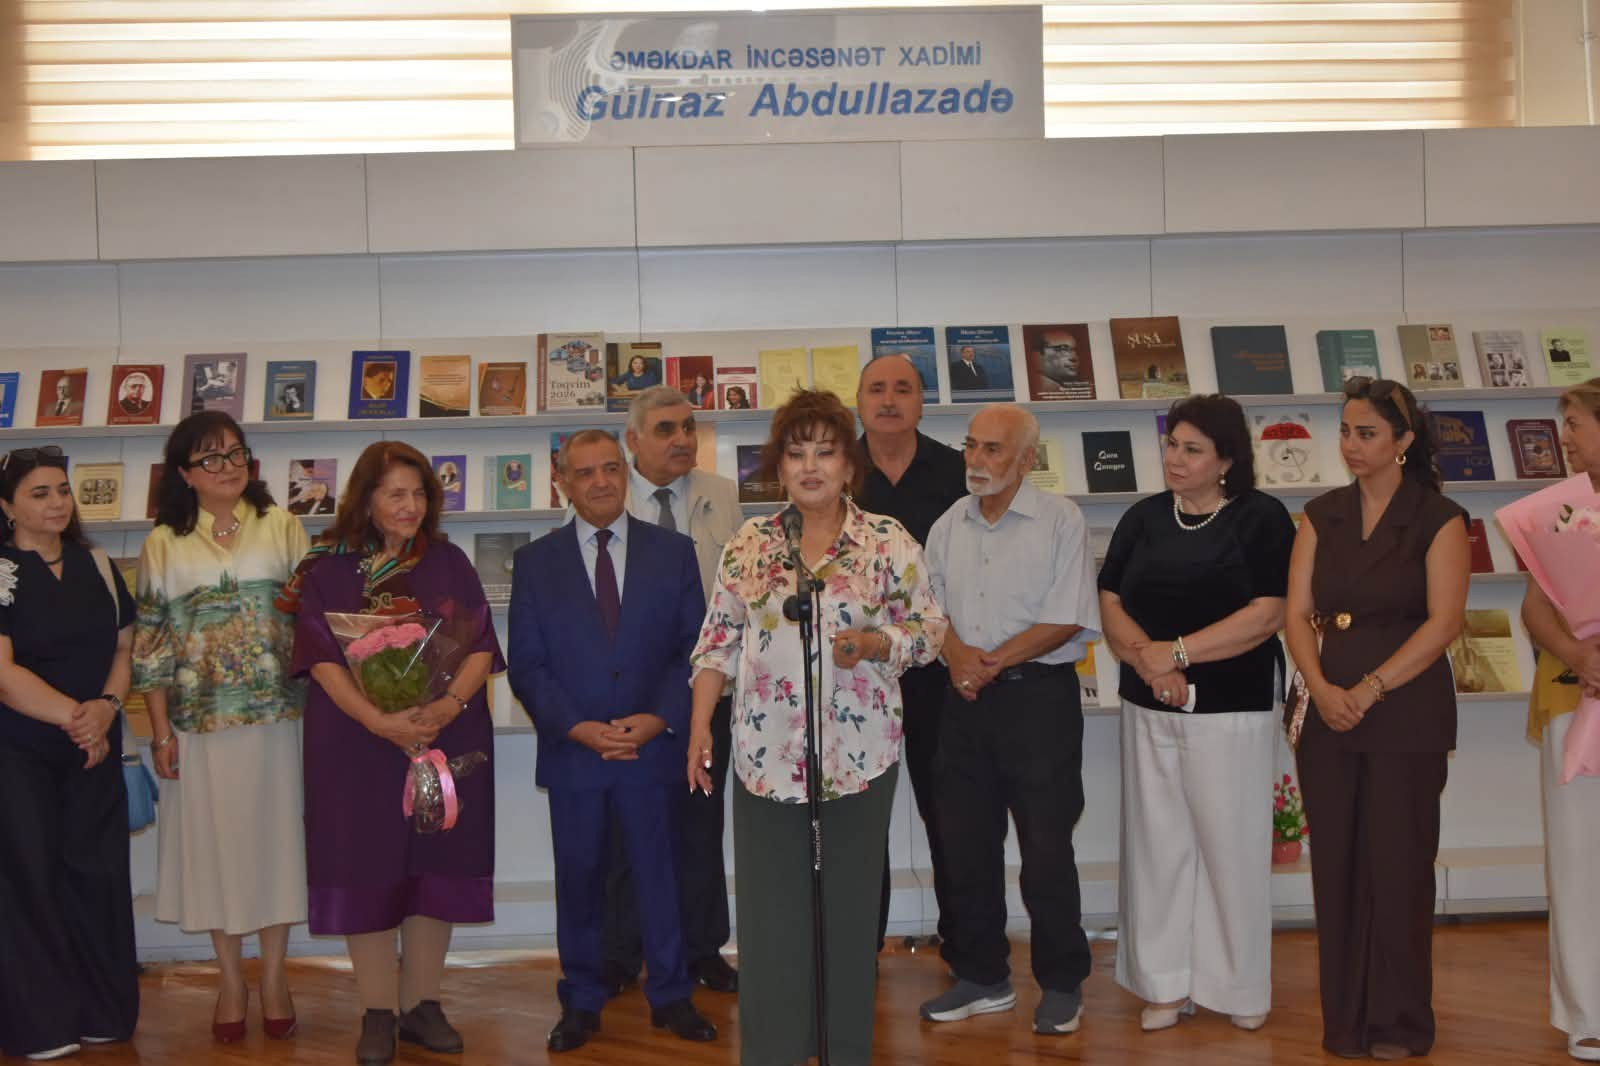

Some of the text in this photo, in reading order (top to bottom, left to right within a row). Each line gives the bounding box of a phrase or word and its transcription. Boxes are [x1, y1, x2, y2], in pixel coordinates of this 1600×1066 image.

[610, 40, 982, 71] ƏMƏKDAR İNCƏSƏNƏT XADİMİ
[577, 79, 1014, 121] Gülnaz Abdullazadə
